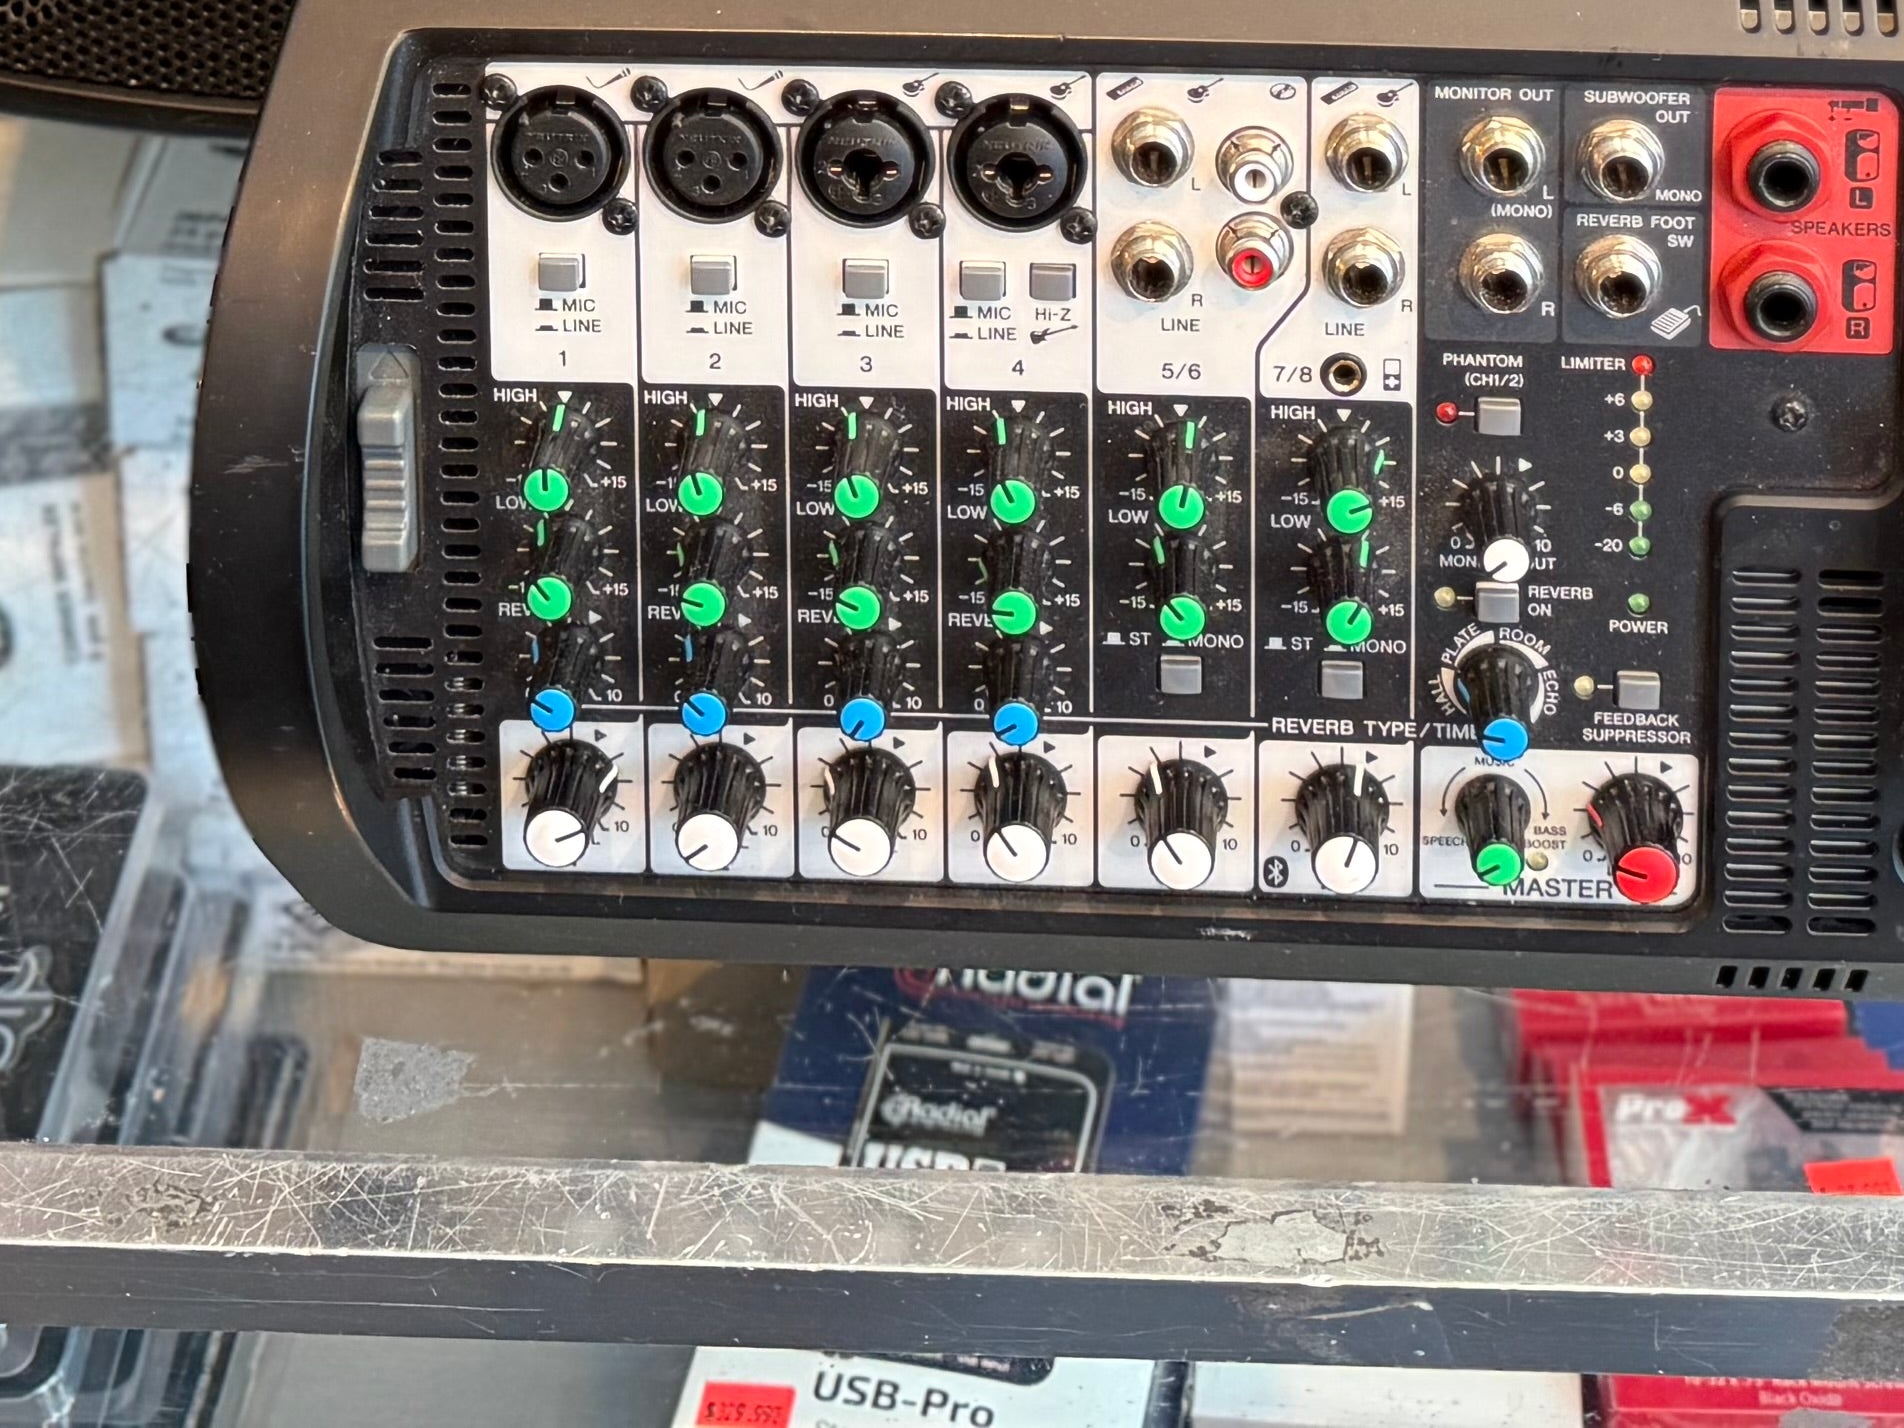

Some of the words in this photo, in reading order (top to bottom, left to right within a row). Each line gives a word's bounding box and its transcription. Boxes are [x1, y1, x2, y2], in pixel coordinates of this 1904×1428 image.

[1434, 86, 1512, 102] MONITOR
[1519, 88, 1555, 103] OUT
[1584, 89, 1691, 105] SUBWOOFER
[1655, 109, 1689, 124] OUT
[1191, 177, 1201, 192] L
[1402, 182, 1412, 196] L
[1542, 185, 1555, 201] L
[1654, 189, 1703, 203] MONO
[1855, 190, 1868, 206] L
[1490, 203, 1553, 219] (MONO)
[1576, 213, 1643, 229] REVERB
[1650, 215, 1696, 230] FOOT
[1790, 220, 1892, 237] SPEAKERS
[1667, 233, 1694, 248] SW
[561, 297, 596, 314] MIC
[712, 299, 748, 316] MIC
[1191, 293, 1204, 308] R
[1401, 299, 1413, 313] R
[863, 302, 899, 319] MIC
[976, 303, 1012, 321] MIC
[1034, 306, 1072, 323] Hi-Z
[1541, 302, 1556, 318] R
[562, 317, 602, 334] LINE
[712, 319, 753, 336] LINE
[864, 322, 905, 339] LINE
[976, 324, 1017, 341] LINE
[1161, 318, 1201, 333] LINE
[1324, 322, 1365, 337] LINE
[1850, 320, 1866, 336] R
[556, 349, 568, 368] 1
[708, 352, 722, 370] 2
[859, 355, 873, 373] 3
[1442, 353, 1523, 369] PHANTOM
[1561, 356, 1626, 371] LIMITER
[1010, 358, 1025, 377] 4
[1161, 363, 1202, 380] 5/6
[1273, 366, 1313, 383] 7/8
[1464, 373, 1525, 388] (CH1/2)
[493, 388, 538, 403] HIGH
[643, 390, 688, 405] HIGH
[794, 393, 839, 409] HIGH
[1604, 393, 1625, 406] +6
[945, 396, 991, 412] HIGH
[1107, 400, 1153, 416] HIGH
[1270, 405, 1316, 421] HIGH
[1604, 430, 1625, 443] +3
[1612, 466, 1624, 479] 0
[600, 476, 627, 489] +15
[751, 478, 777, 491] +15
[902, 482, 929, 495] +15
[1053, 486, 1080, 499] +15
[1215, 490, 1242, 503] +15
[796, 501, 835, 516] LOW
[1378, 494, 1405, 508] +15
[947, 505, 988, 520] LOW
[1108, 509, 1149, 524] LOW
[1270, 513, 1312, 529] LOW
[1450, 536, 1461, 549] 0
[1534, 538, 1552, 553] 10
[602, 583, 629, 596] +15
[752, 586, 779, 599] +15
[902, 590, 929, 603] +15
[1527, 586, 1594, 600] REVERB
[1054, 593, 1081, 607] +15
[1215, 599, 1242, 612] +15
[1377, 604, 1405, 617] +15
[1527, 603, 1552, 617] ON
[1608, 619, 1669, 635] POWER
[1129, 631, 1152, 646] ST
[1187, 634, 1245, 649] MONO
[1291, 637, 1314, 651] ST
[1440, 622, 1481, 665] PLATE
[1499, 626, 1553, 655] ROOM
[1349, 639, 1407, 655] MONO
[606, 689, 623, 702] 10
[755, 693, 772, 706] 10
[1427, 674, 1456, 715] HALL
[1542, 668, 1560, 716] ECHO
[905, 696, 922, 710] 10
[1056, 700, 1073, 713] 10
[1271, 717, 1354, 737] REVERB
[1593, 712, 1679, 727] FEEDBACK
[1582, 728, 1692, 744] SUPPRESSOR
[614, 820, 630, 833] 10
[763, 824, 779, 837] 10
[1533, 826, 1567, 837] BASS
[912, 829, 928, 841] 10
[1061, 832, 1078, 845] 10
[1222, 838, 1238, 851] 10
[1383, 842, 1400, 856] 10
[1502, 877, 1614, 900] MASTER
[812, 1370, 995, 1428] USB-Pro
